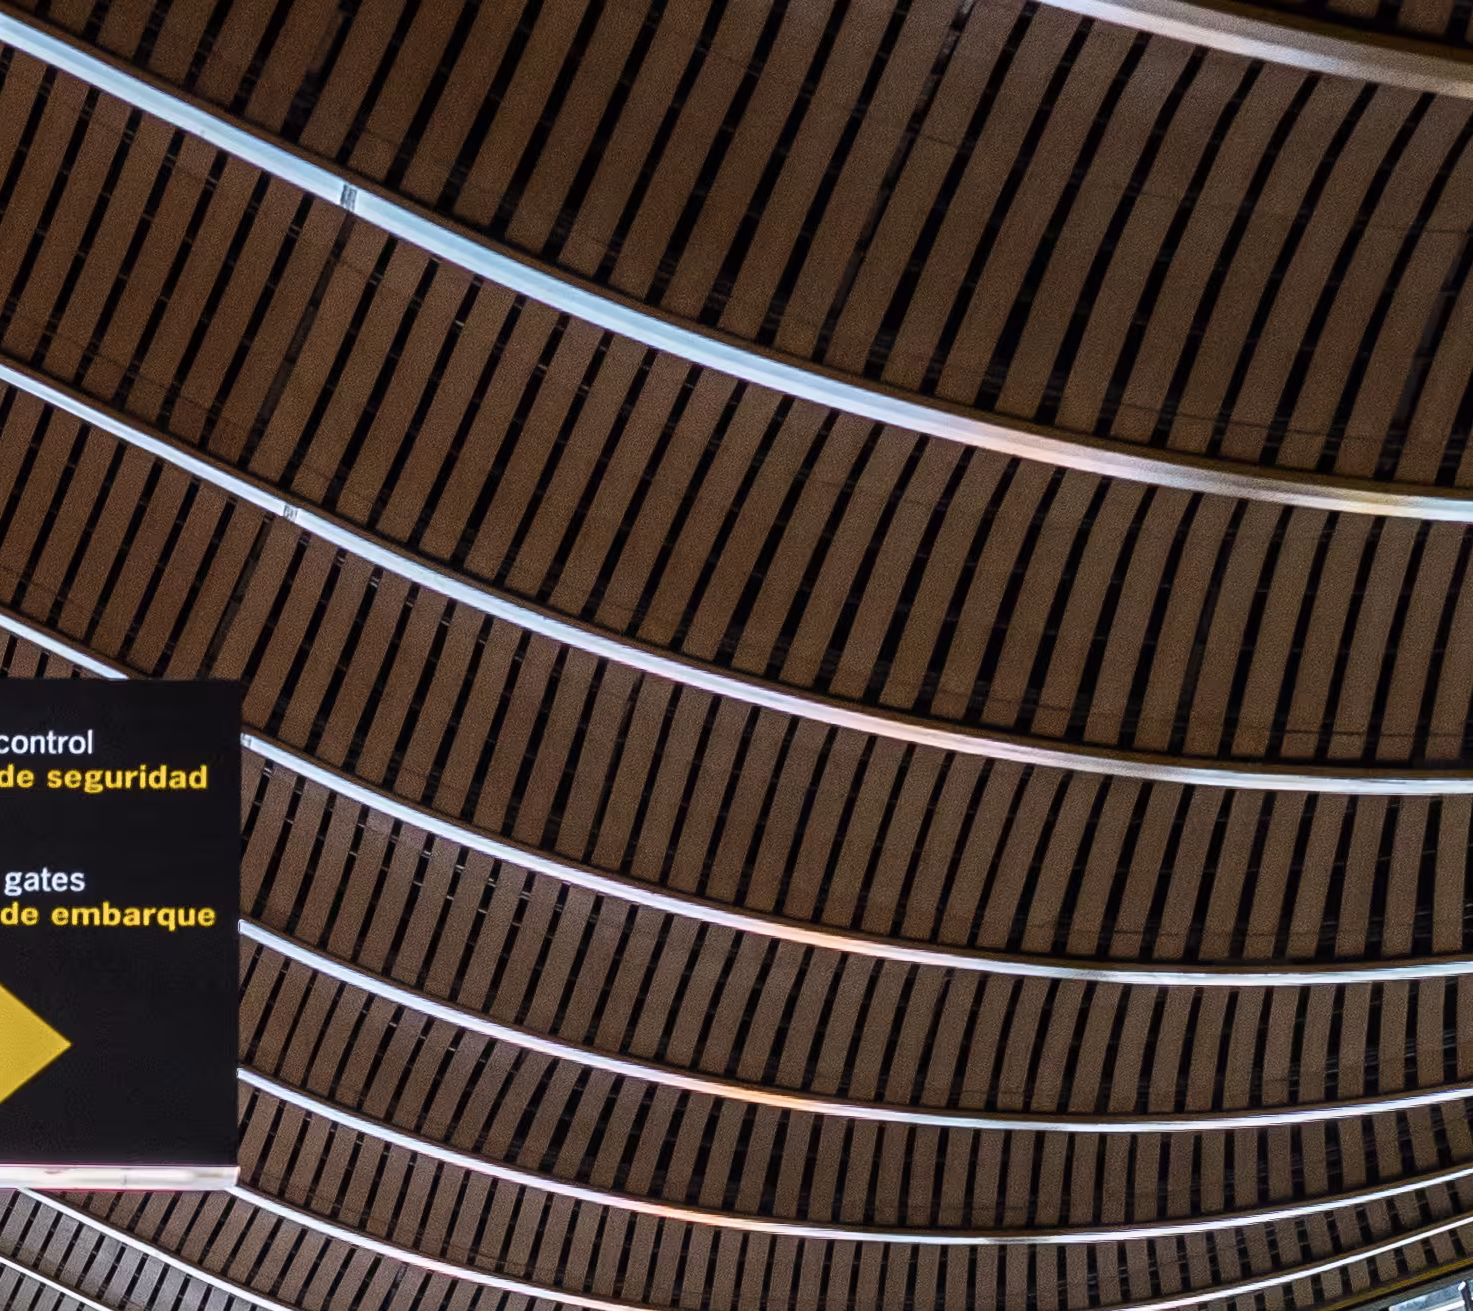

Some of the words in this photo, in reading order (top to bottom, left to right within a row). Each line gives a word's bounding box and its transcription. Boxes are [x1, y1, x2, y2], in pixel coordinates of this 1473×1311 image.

[46, 764, 209, 794] seguridad
[3, 867, 86, 897] gates
[0, 901, 39, 926] de
[50, 902, 217, 932] embarque
